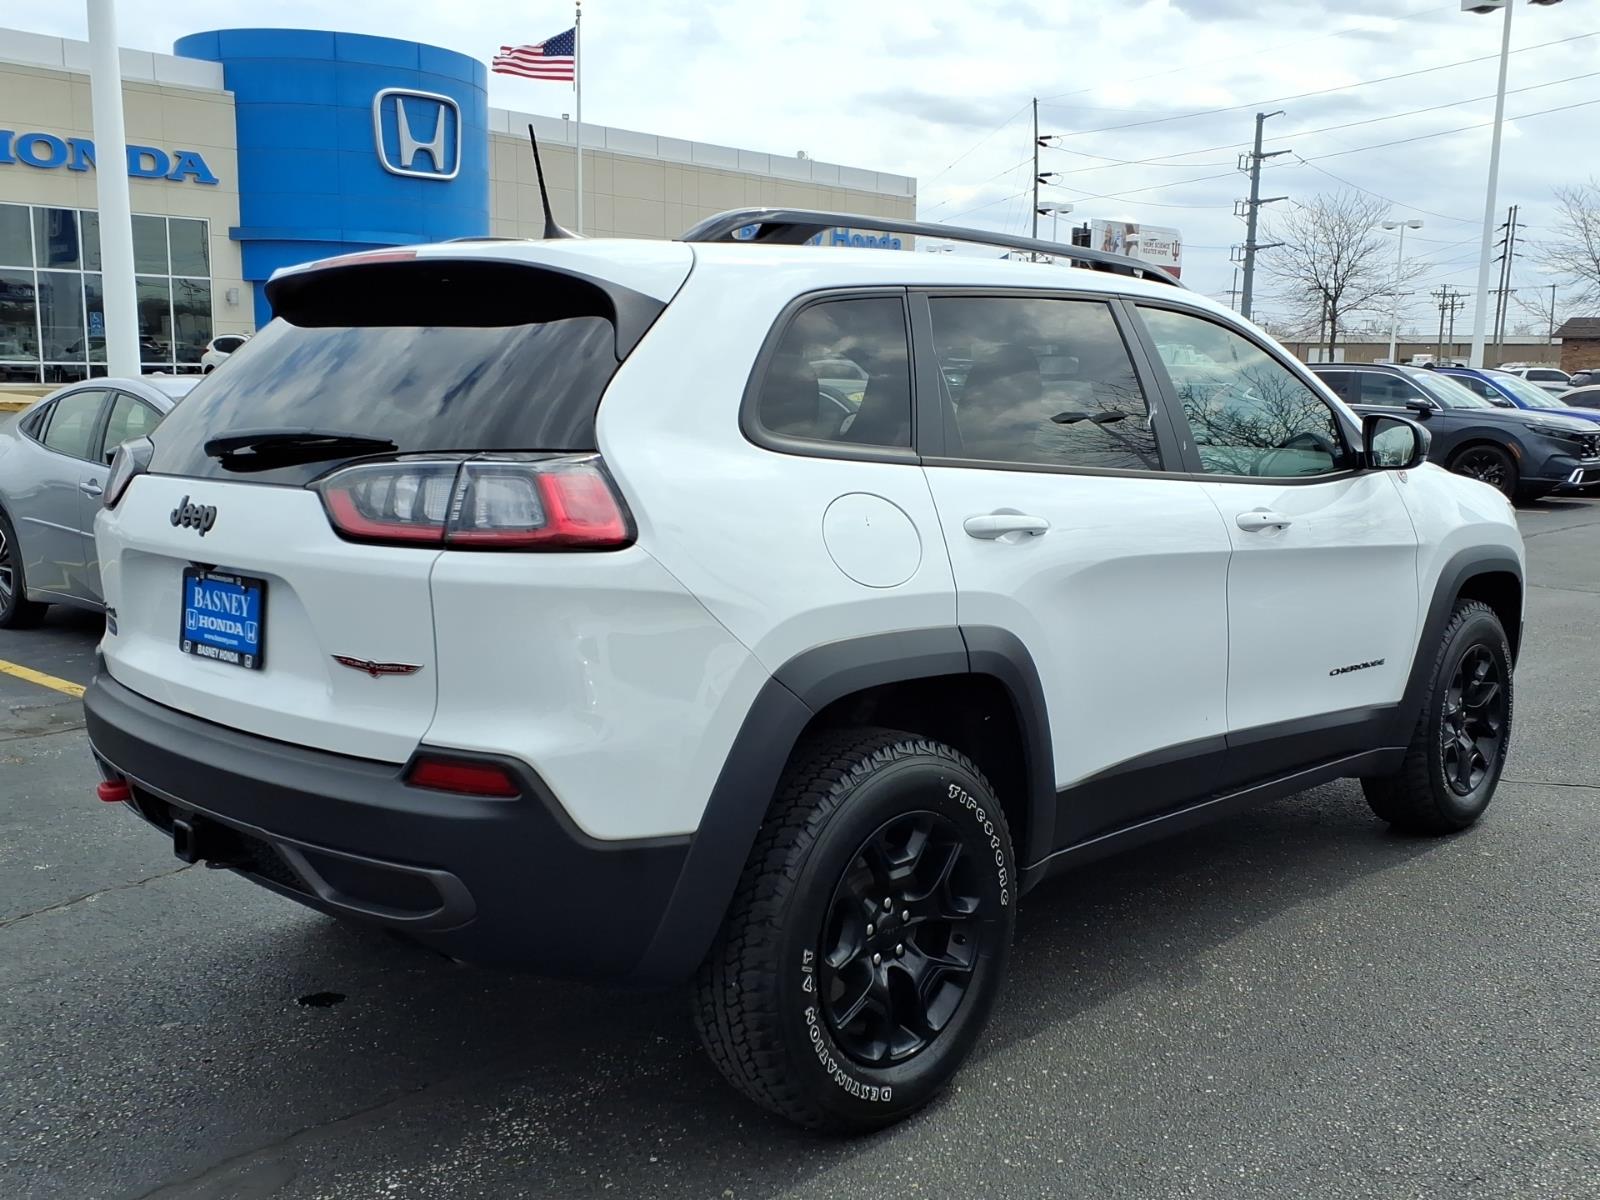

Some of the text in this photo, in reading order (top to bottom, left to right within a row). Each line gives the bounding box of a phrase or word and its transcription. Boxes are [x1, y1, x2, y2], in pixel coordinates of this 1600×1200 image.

[170, 495, 217, 537] Jeep
[193, 586, 251, 617] BASNEY
[198, 614, 245, 636] HONDA
[197, 643, 240, 664] BASNEY HONDA
[1329, 657, 1386, 676] CHEROKEE
[804, 1006, 892, 1102] DESTINATION
